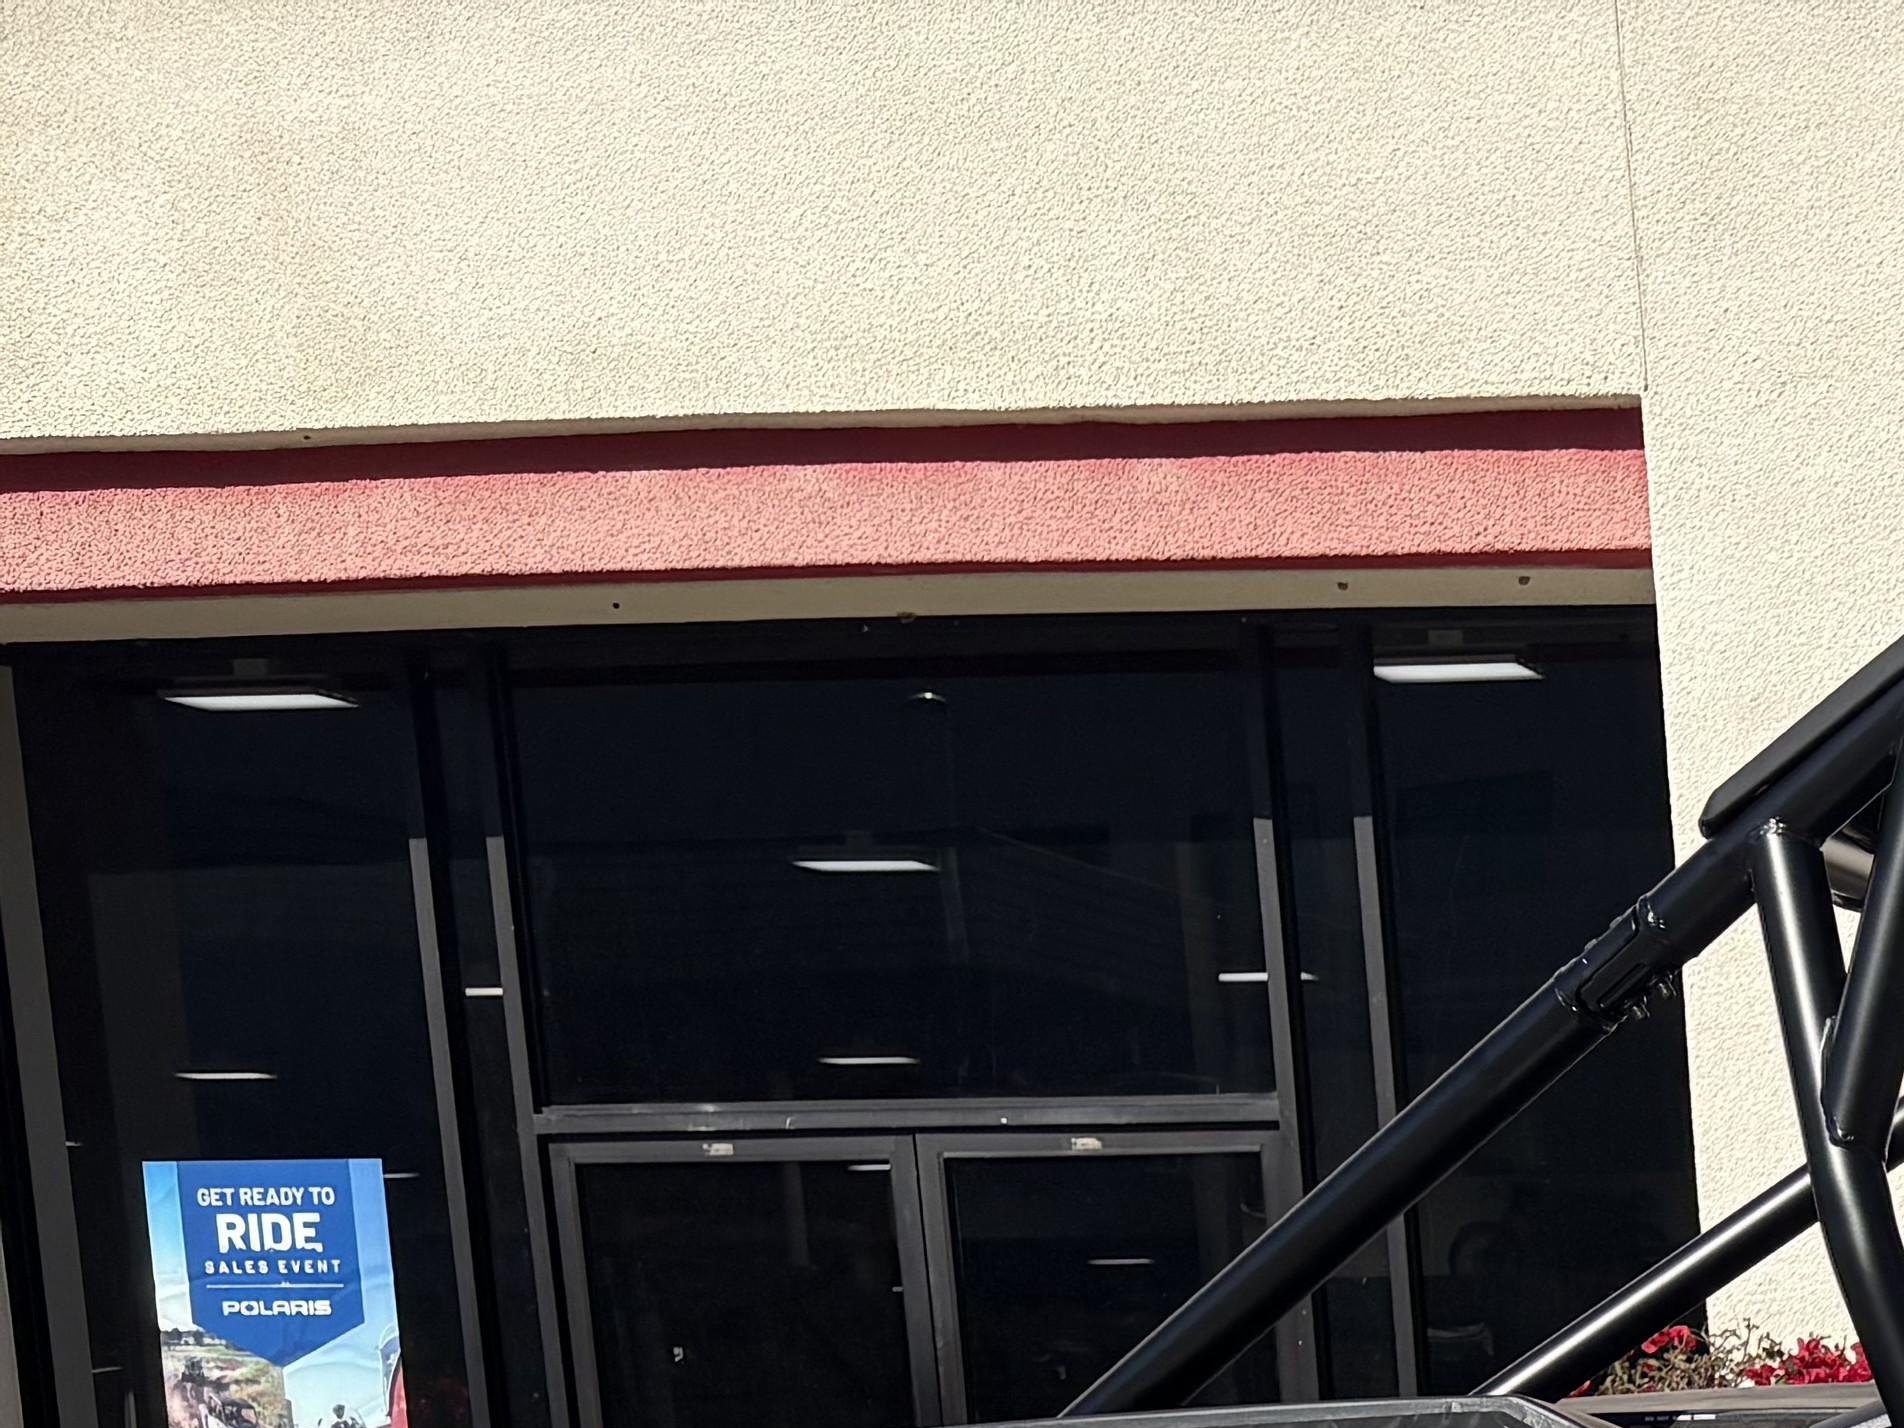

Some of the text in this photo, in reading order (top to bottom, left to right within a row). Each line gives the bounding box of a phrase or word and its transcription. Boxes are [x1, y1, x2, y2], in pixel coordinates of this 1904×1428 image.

[196, 1186, 336, 1207] GET READY TO
[215, 1212, 324, 1254] RIDE
[204, 1259, 341, 1275] SALES EVENT
[222, 1300, 332, 1316] POLARIS
